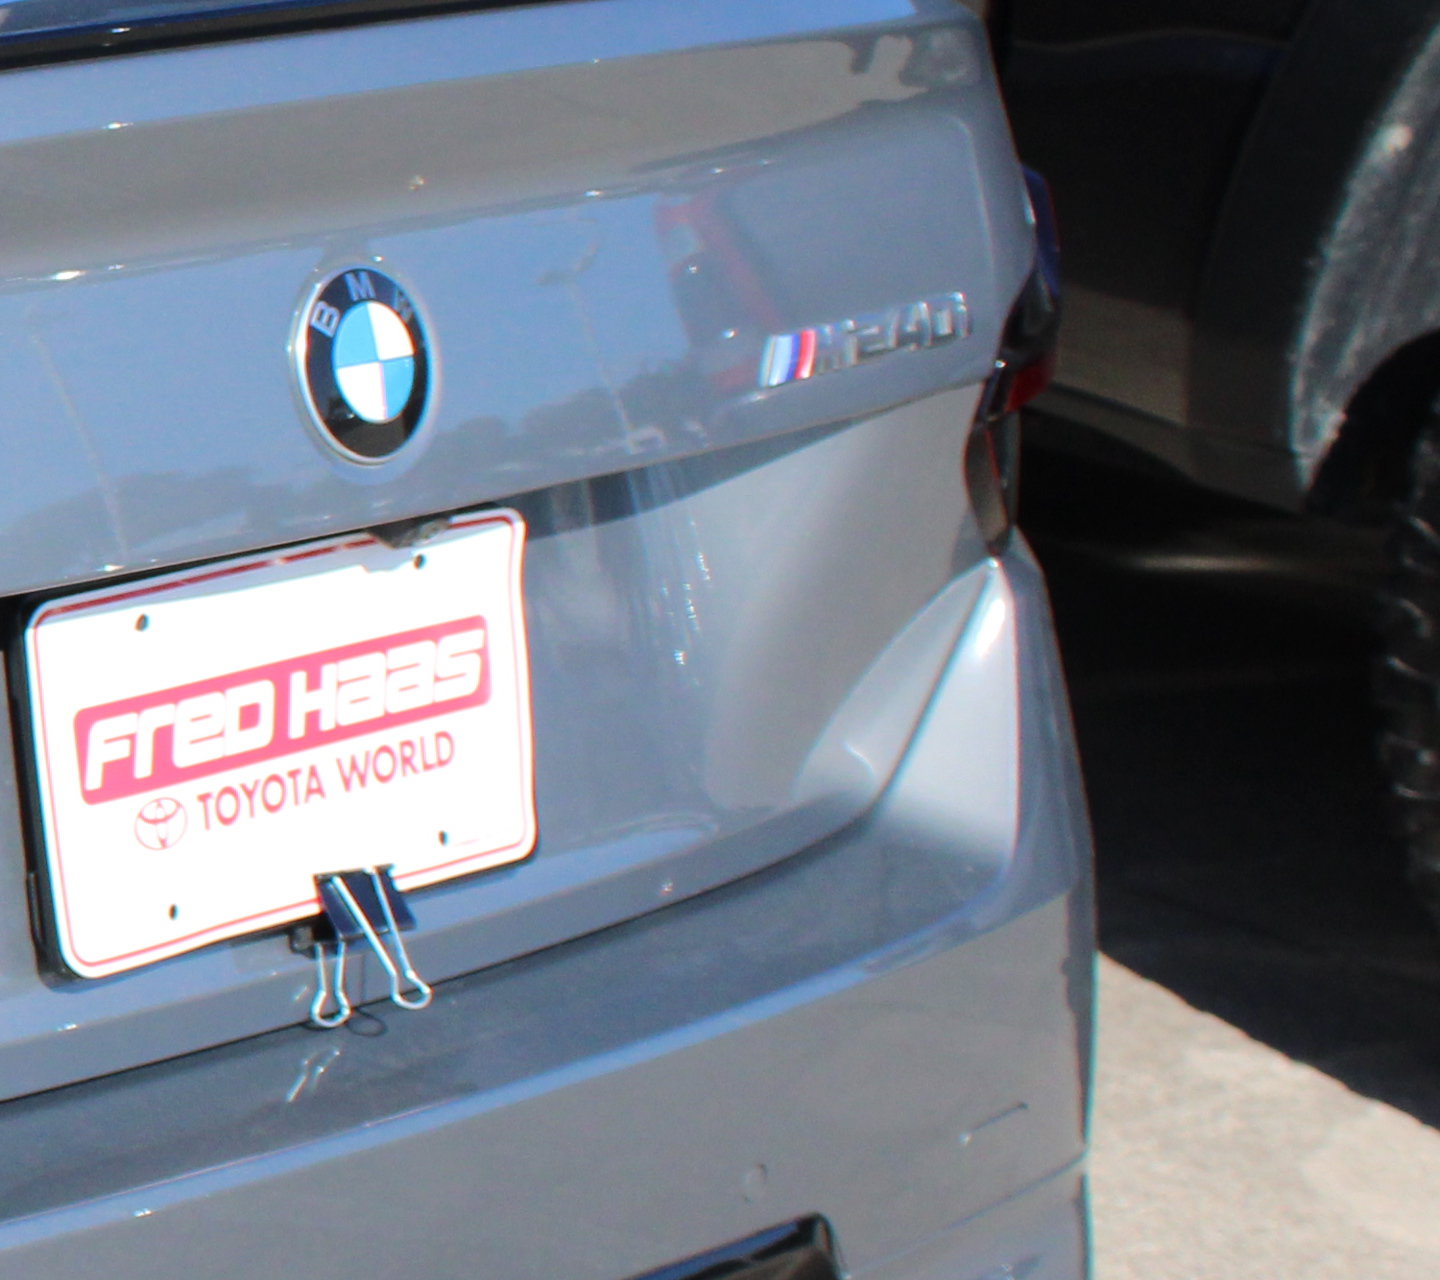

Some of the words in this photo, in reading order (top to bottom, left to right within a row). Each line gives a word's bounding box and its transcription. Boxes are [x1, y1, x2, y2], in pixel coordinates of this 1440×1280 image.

[309, 270, 415, 338] BMW
[196, 763, 327, 831] TOYOTA
[335, 730, 456, 793] WORLD
